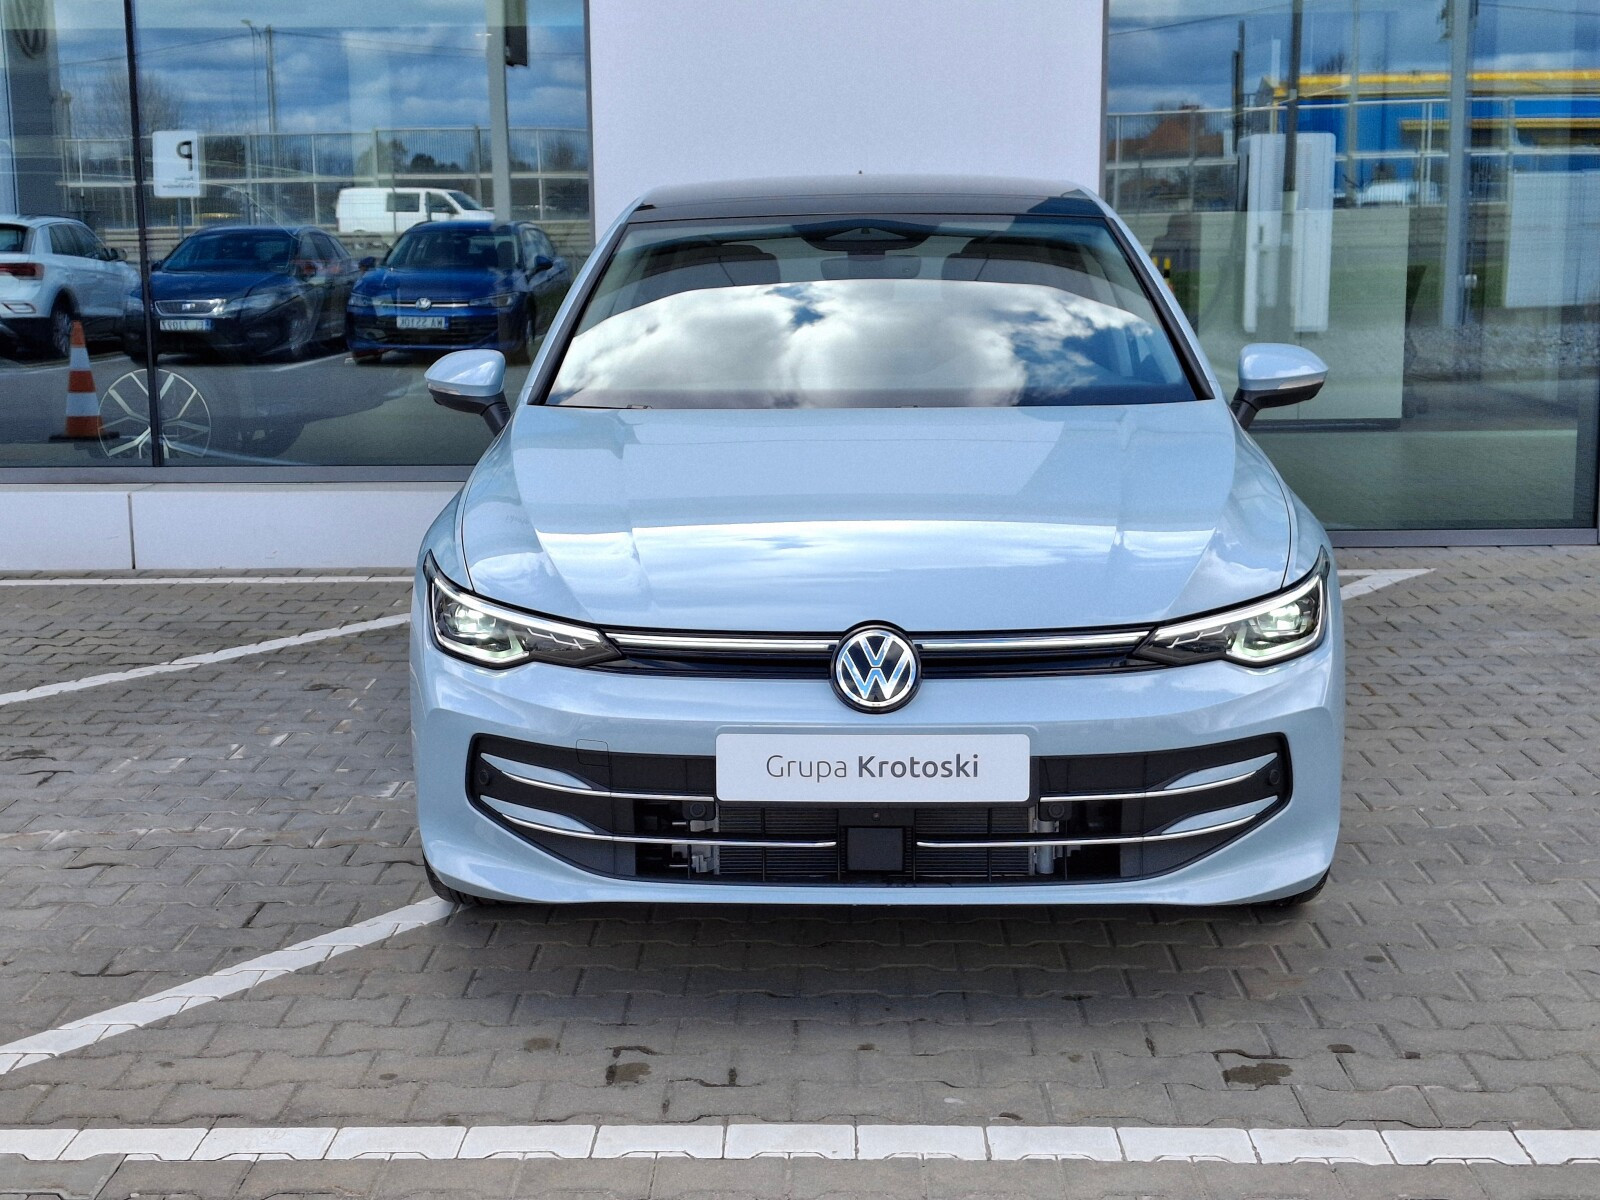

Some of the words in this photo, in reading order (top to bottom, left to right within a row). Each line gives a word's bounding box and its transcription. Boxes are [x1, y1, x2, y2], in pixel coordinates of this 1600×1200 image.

[838, 631, 914, 705] VW
[766, 754, 847, 783] Grupa
[858, 753, 979, 778] Krotoski
